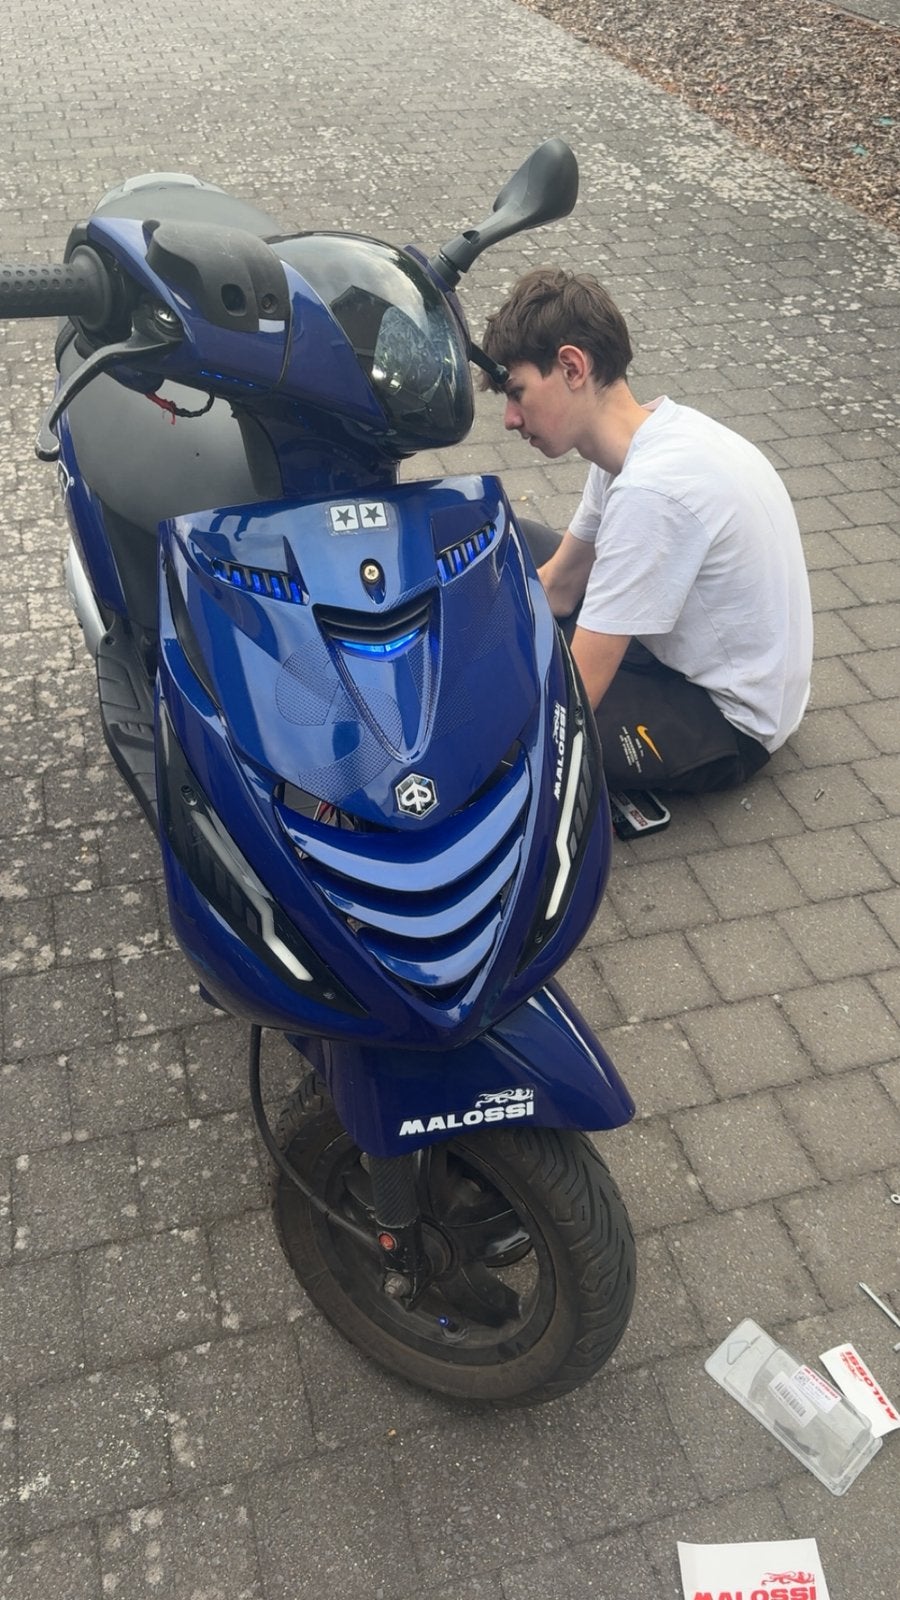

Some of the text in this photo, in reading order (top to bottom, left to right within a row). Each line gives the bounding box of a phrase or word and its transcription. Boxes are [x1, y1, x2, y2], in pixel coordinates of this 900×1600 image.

[554, 706, 566, 800] MALOSSI
[399, 1101, 534, 1136] MALOSSI
[845, 1351, 898, 1420] MALOSSI
